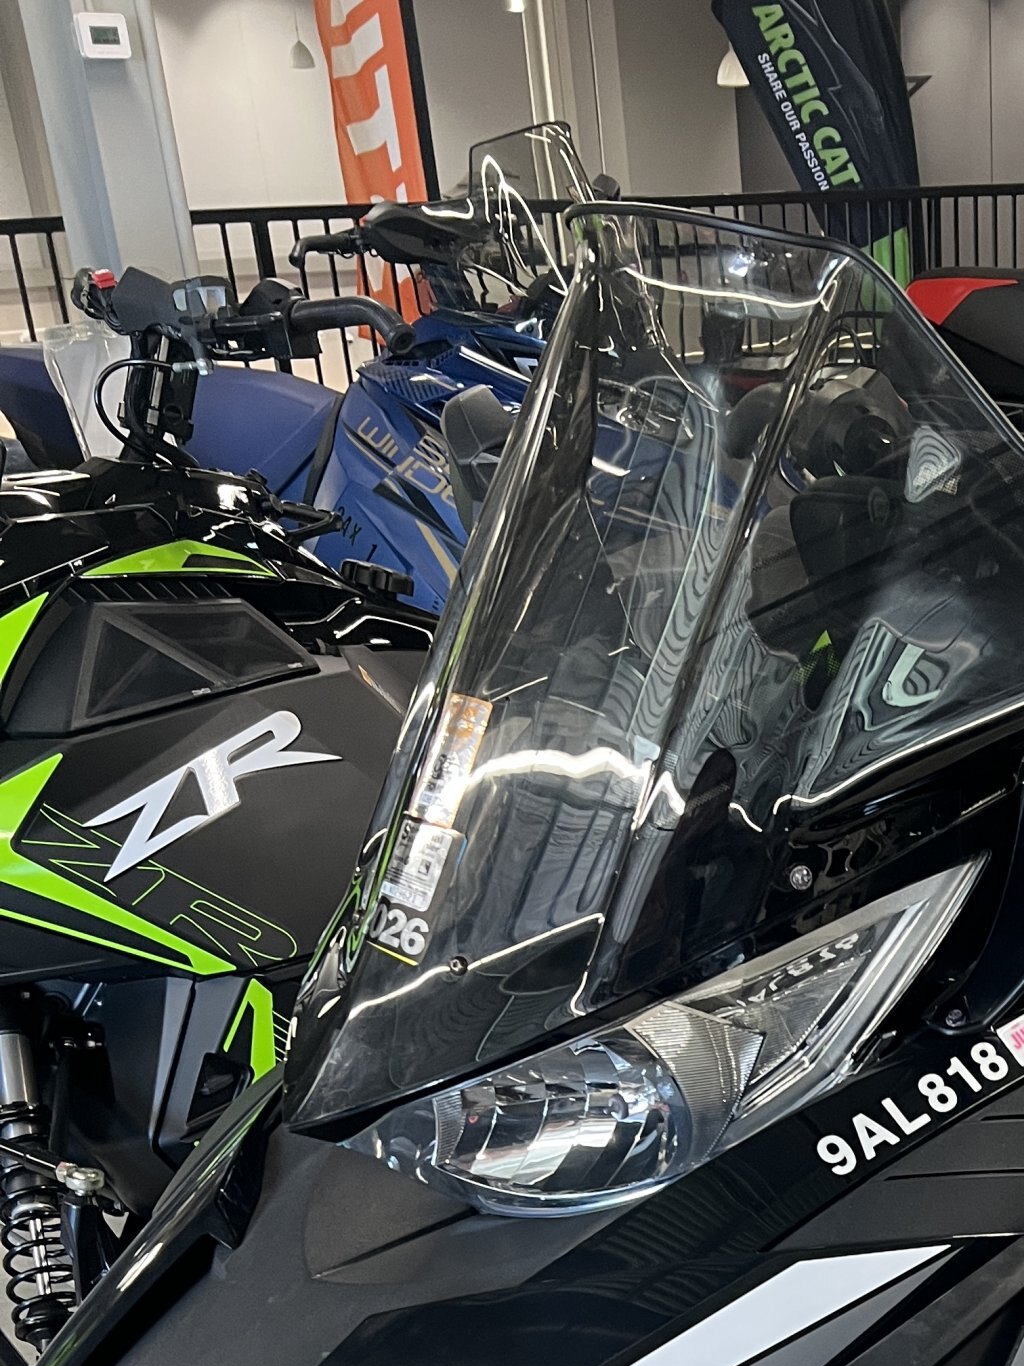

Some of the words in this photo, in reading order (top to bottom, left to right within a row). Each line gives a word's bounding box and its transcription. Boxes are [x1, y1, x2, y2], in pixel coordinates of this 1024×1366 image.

[752, 4, 829, 124] ARCTIC
[813, 126, 861, 187] CAT
[758, 52, 787, 101] SHARE
[780, 101, 801, 131] OUR
[795, 132, 830, 191] PASSION
[83, 710, 343, 883] ZR
[817, 1041, 1010, 1176] 9AL818
